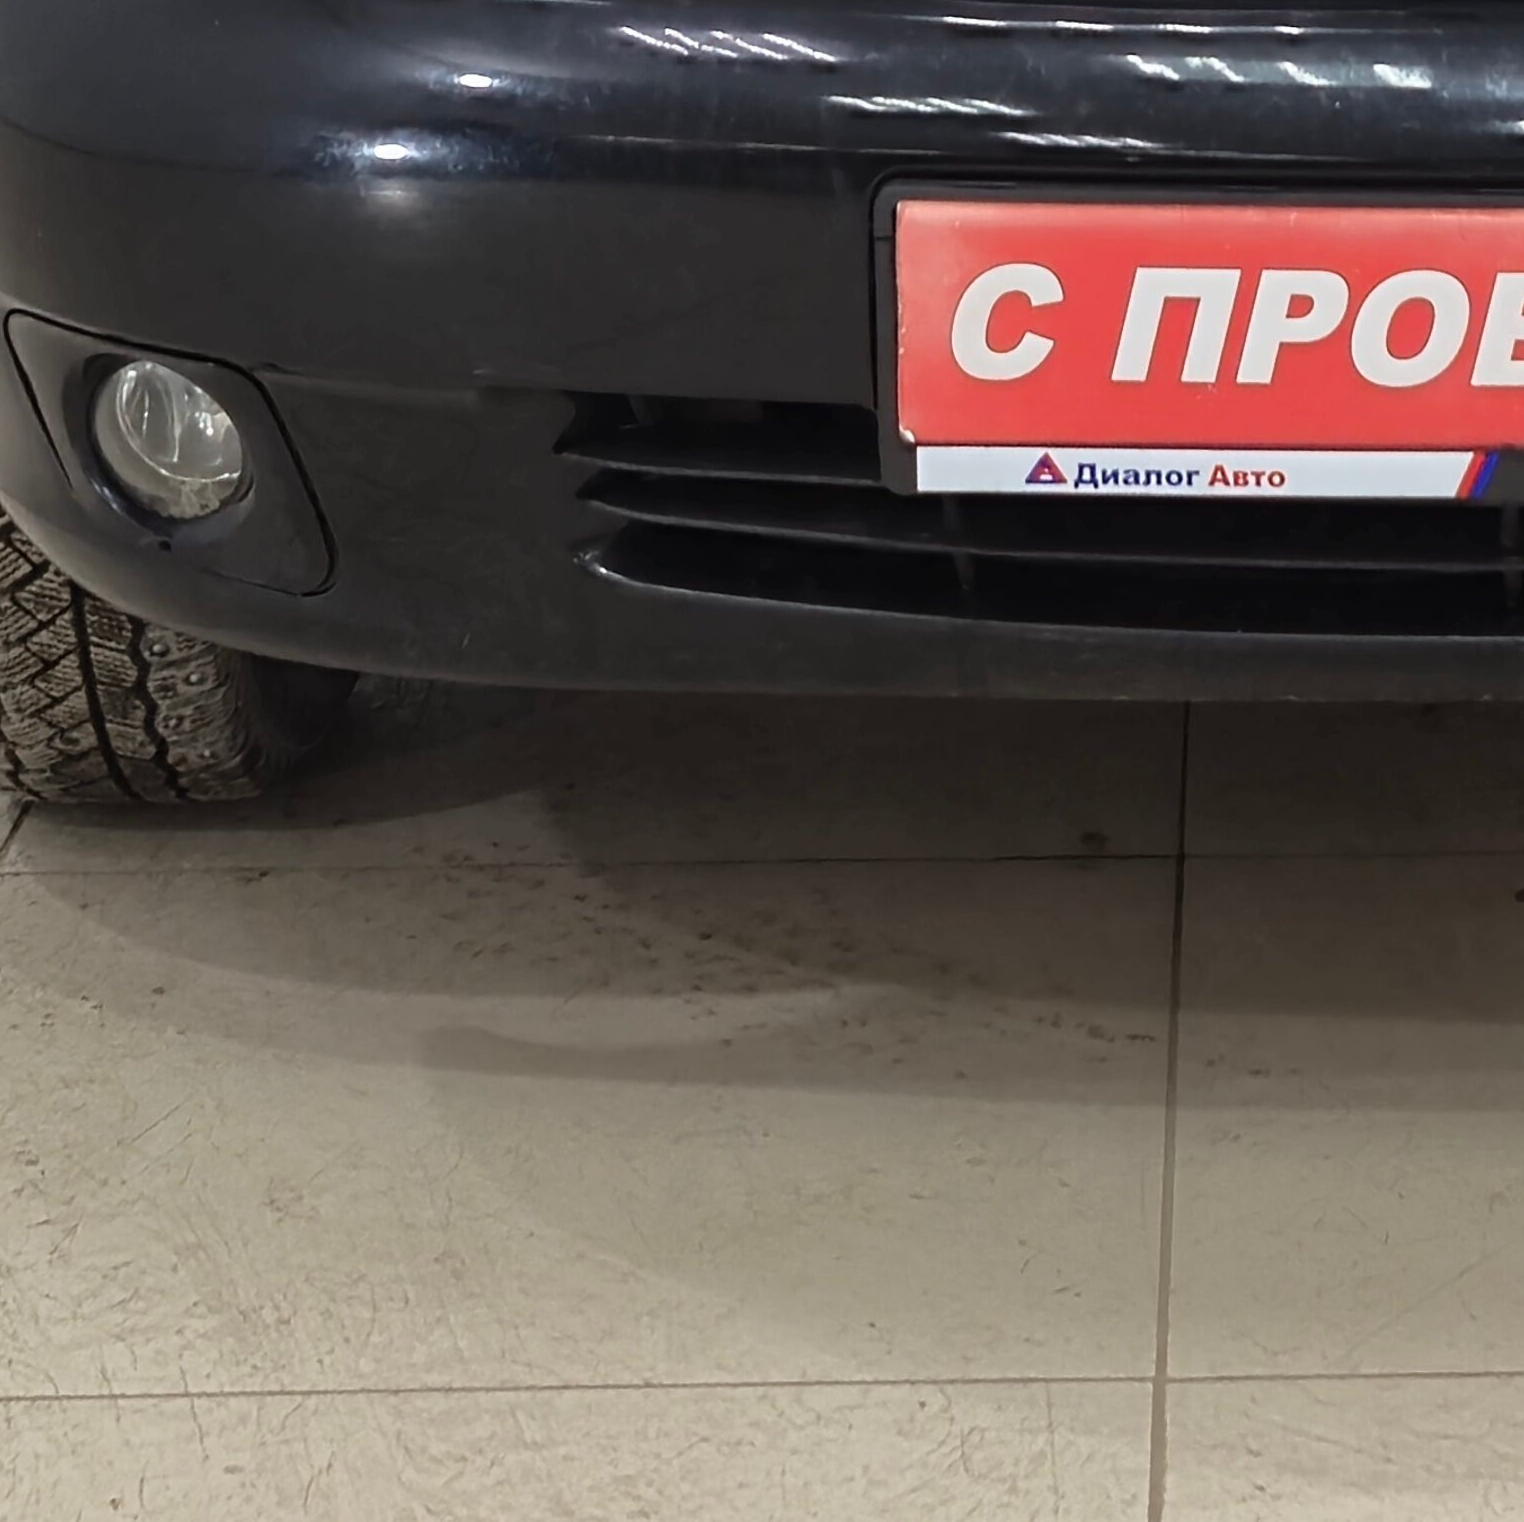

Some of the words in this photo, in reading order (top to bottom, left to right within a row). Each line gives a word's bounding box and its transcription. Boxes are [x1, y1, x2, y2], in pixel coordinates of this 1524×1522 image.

[951, 263, 1064, 380] С
[1074, 462, 1199, 489] Диалог
[1208, 464, 1286, 487] Авто
